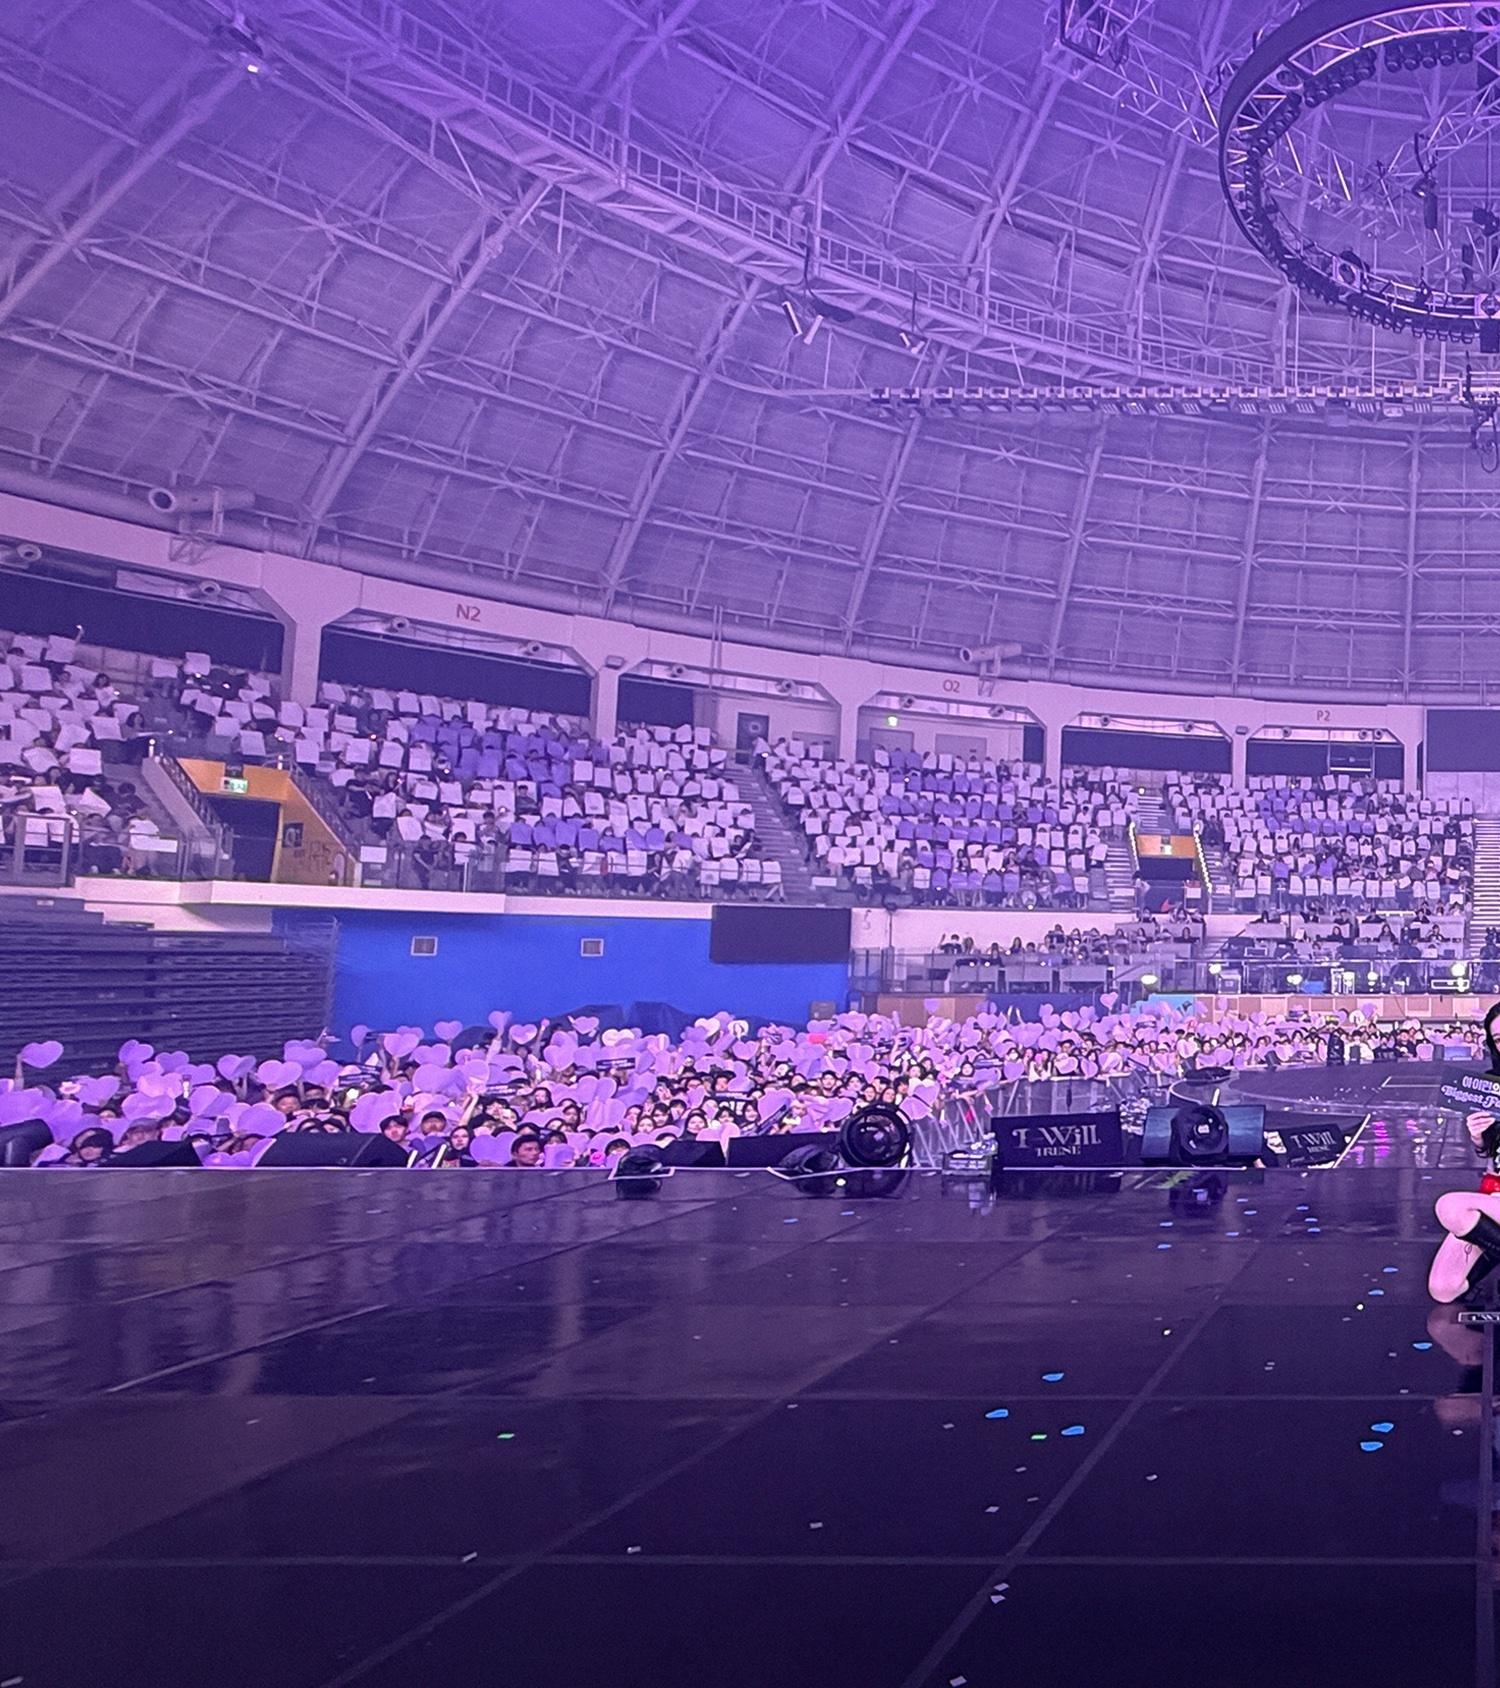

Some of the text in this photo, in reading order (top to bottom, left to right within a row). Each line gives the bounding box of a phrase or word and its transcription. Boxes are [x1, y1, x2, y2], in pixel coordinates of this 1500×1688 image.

[456, 603, 481, 622] N2
[943, 679, 961, 693] O2
[1316, 710, 1331, 722] P2
[1441, 1085, 1484, 1104] Biggest
[1012, 1124, 1102, 1149] I Will
[1035, 1146, 1081, 1157] IRENE
